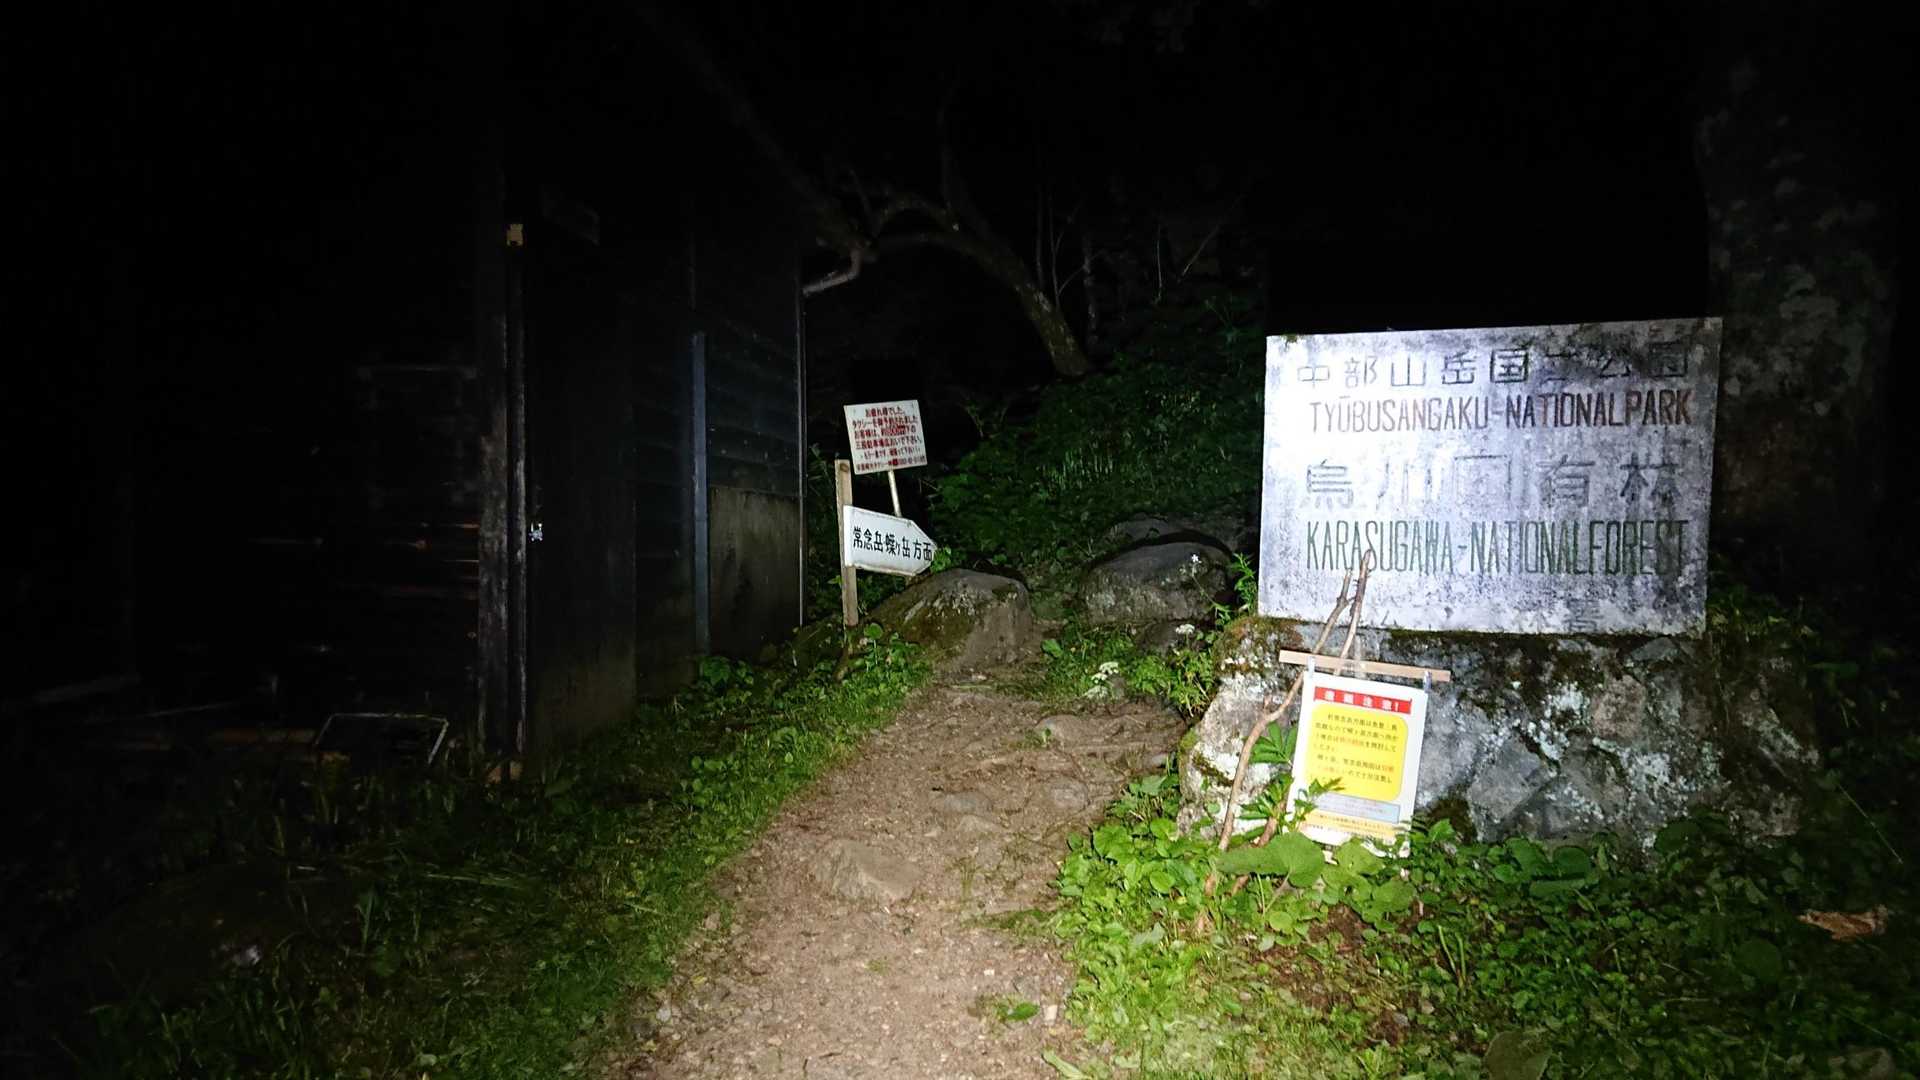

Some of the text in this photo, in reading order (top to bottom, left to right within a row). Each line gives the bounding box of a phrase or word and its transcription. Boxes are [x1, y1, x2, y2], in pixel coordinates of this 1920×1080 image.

[853, 525, 932, 561] 常念岳蝶ヶ岳方面
